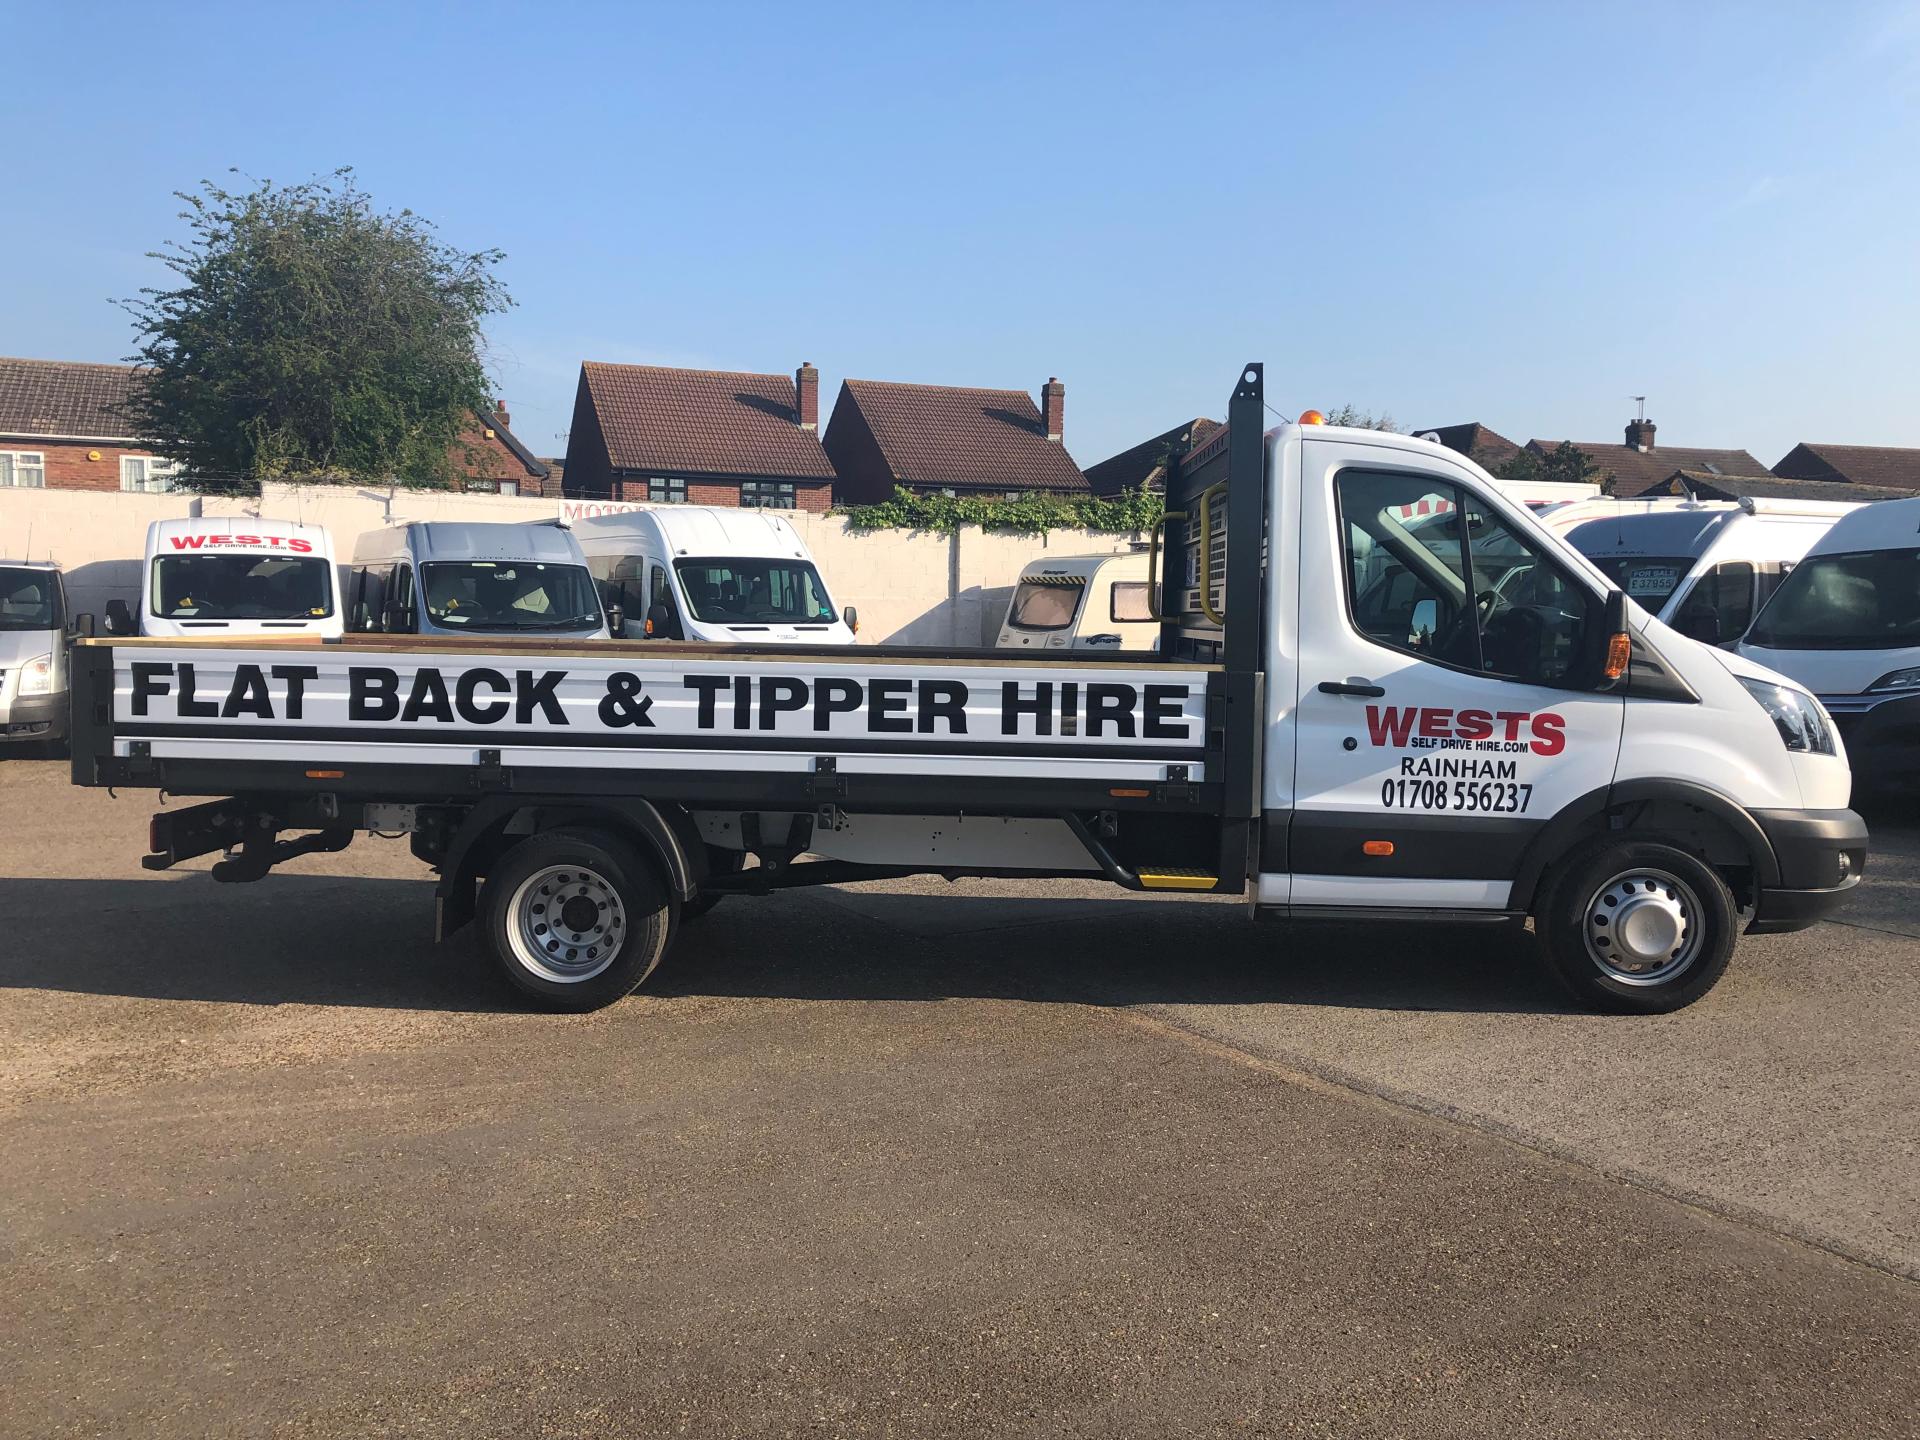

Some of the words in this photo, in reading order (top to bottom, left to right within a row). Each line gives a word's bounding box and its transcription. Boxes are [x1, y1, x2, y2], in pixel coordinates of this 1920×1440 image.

[170, 535, 313, 553] WESTS
[1632, 570, 1651, 578] FOR
[1653, 569, 1676, 577] SALE
[130, 662, 319, 719] FLAT
[348, 666, 570, 725] BACK
[597, 671, 657, 728] &
[683, 675, 969, 734] TIPPER
[1001, 681, 1190, 739] HIRE
[1365, 705, 1566, 757] WESTS
[1411, 737, 1438, 748] SELF
[1441, 739, 1473, 750] DRIVE
[1475, 740, 1529, 753] HIRE.COM
[1401, 757, 1517, 780] RAINHAM
[1381, 778, 1448, 810] 01708
[1453, 781, 1533, 813] 556237
